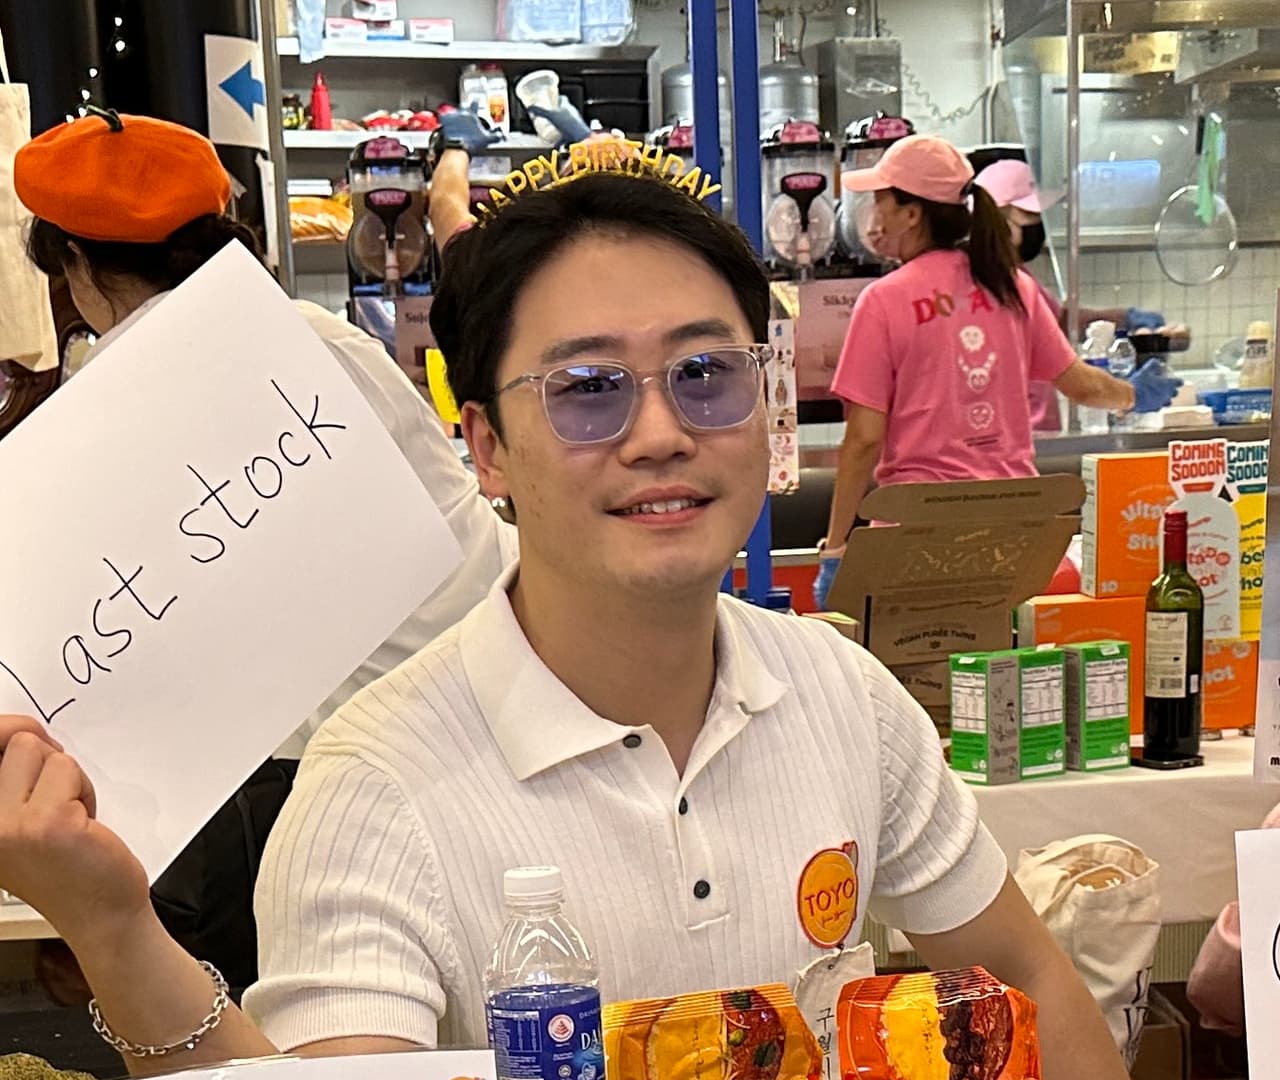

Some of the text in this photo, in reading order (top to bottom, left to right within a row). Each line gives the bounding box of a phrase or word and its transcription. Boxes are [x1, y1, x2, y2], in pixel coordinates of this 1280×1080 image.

[570, 138, 721, 201] BIRTHDAY
[179, 379, 347, 564] stock
[1172, 442, 1225, 462] COMING
[1227, 445, 1269, 464] COMIN
[804, 878, 854, 917] TOYO
